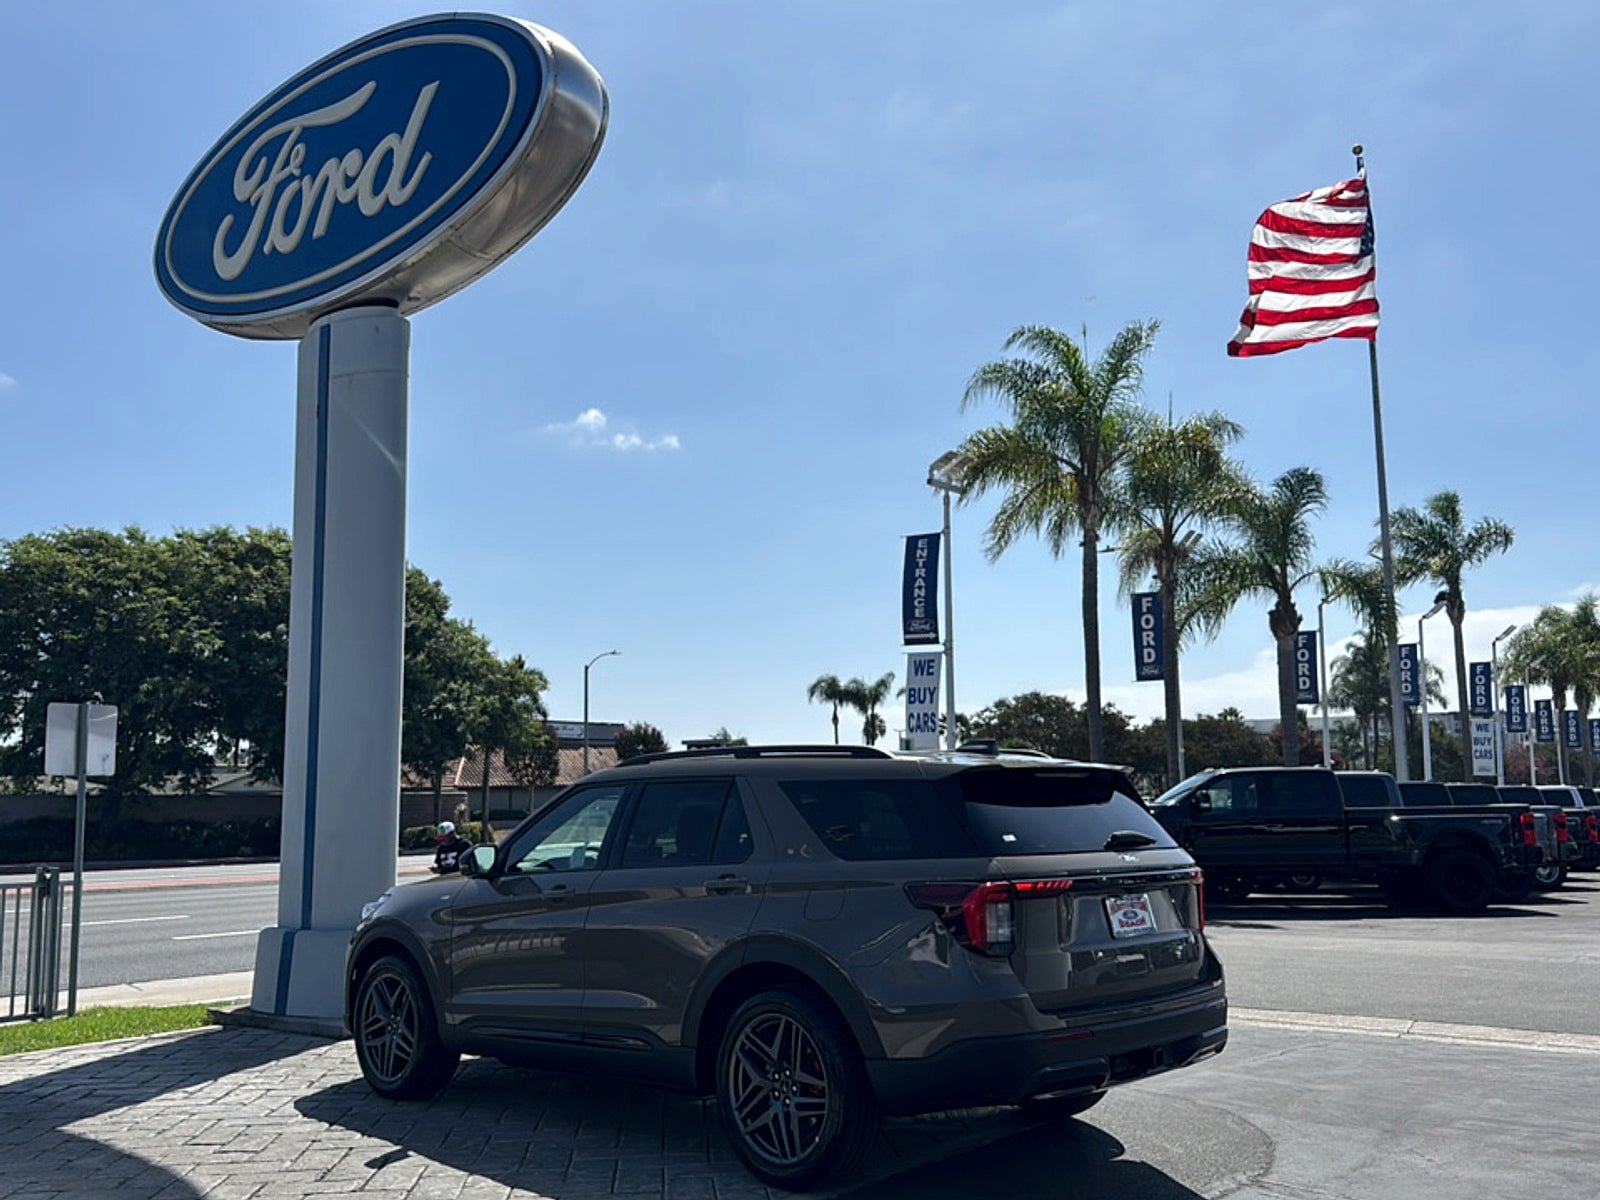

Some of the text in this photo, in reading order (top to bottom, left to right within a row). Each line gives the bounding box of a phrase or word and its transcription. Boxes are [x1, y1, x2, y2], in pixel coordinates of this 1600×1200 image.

[213, 80, 440, 281] Ford
[913, 538, 928, 618] ENTRANCE
[1140, 596, 1157, 664] FORD
[914, 658, 936, 677] WE
[1296, 635, 1310, 690] FORD
[1400, 646, 1412, 694] FORD
[908, 686, 937, 705] BUY
[1475, 665, 1486, 706] FORD
[908, 711, 937, 733] CARS
[1511, 688, 1521, 723] FORD
[1540, 701, 1549, 734] FORD
[1473, 736, 1493, 746] BUY
[1475, 723, 1489, 732] WE
[1568, 712, 1577, 741] FORD
[1473, 749, 1493, 760] CARS
